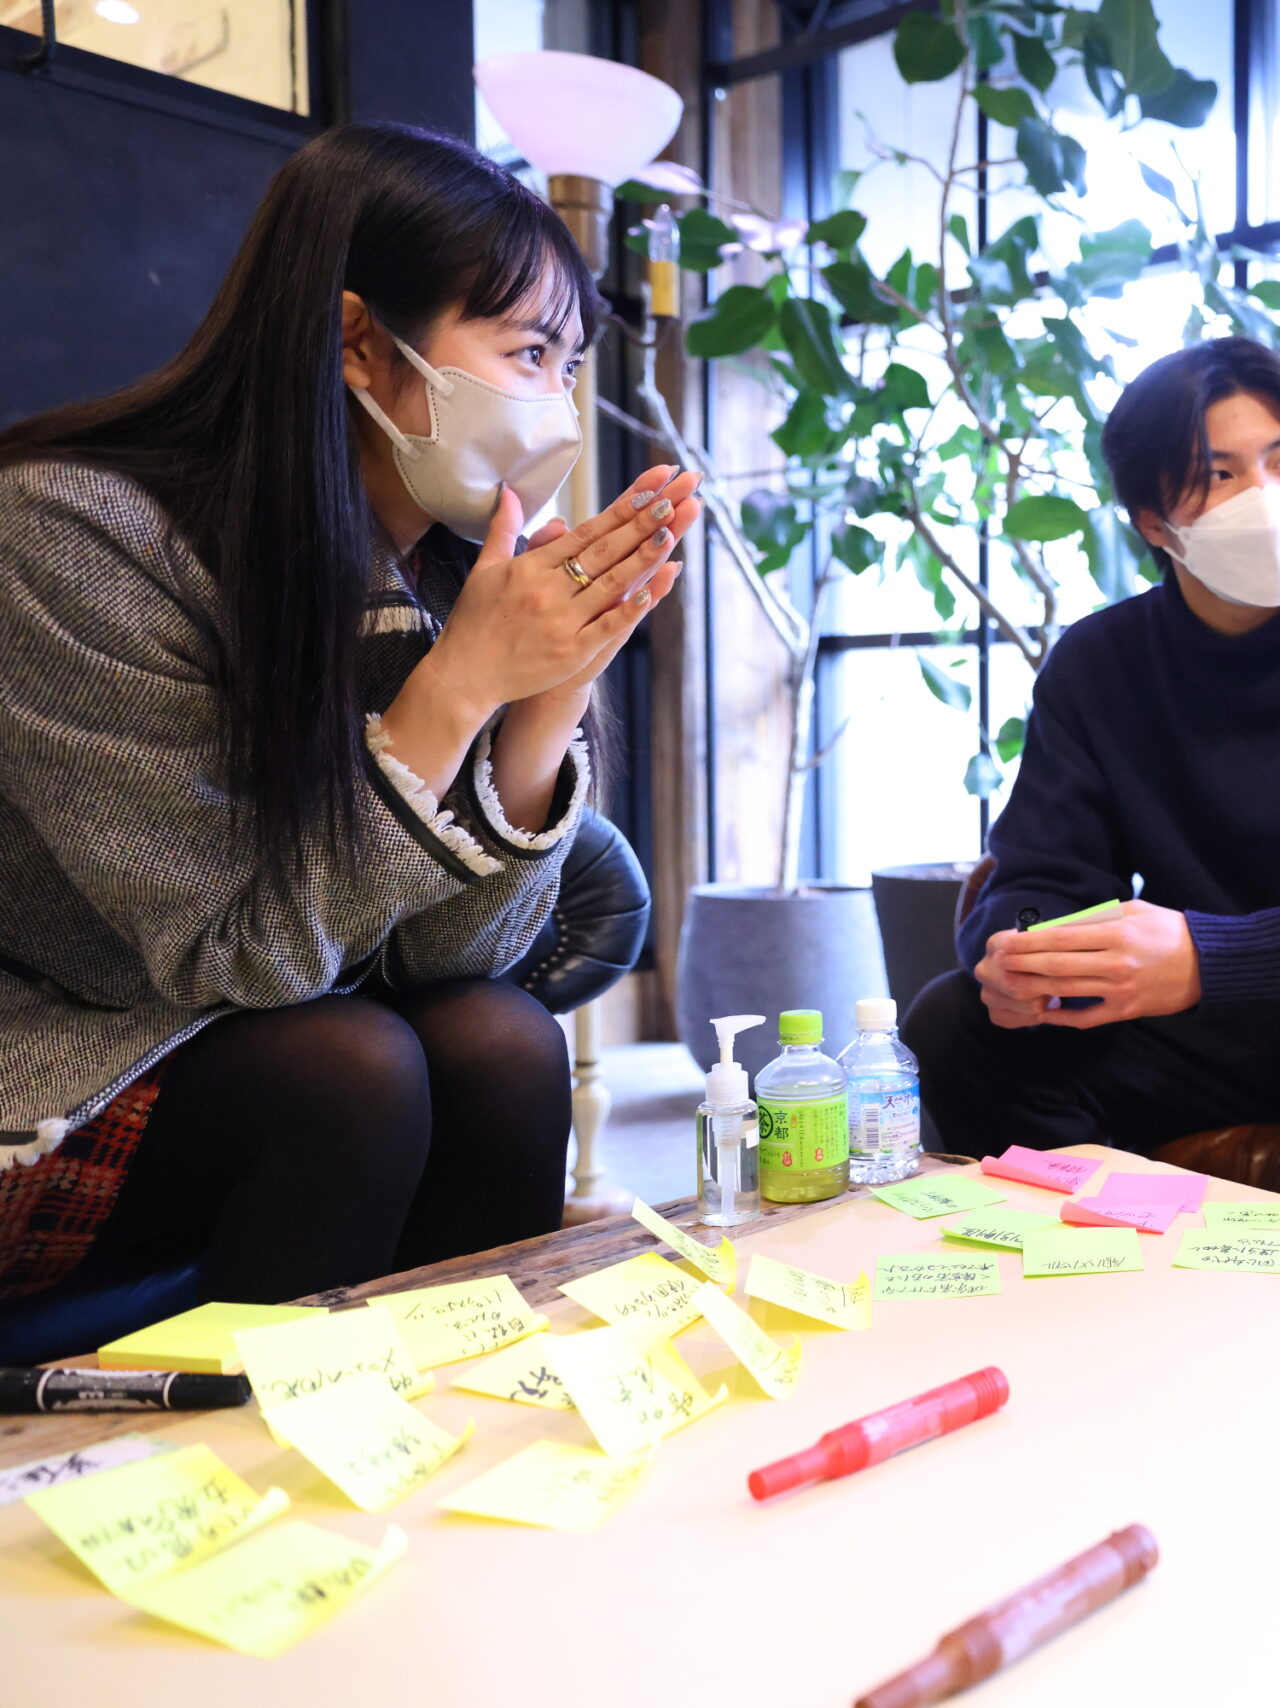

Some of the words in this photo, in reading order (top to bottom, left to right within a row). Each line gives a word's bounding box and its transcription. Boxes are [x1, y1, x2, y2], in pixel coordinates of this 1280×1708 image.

[883, 1092, 914, 1109] 天然水
[774, 1110, 789, 1140] 京都
